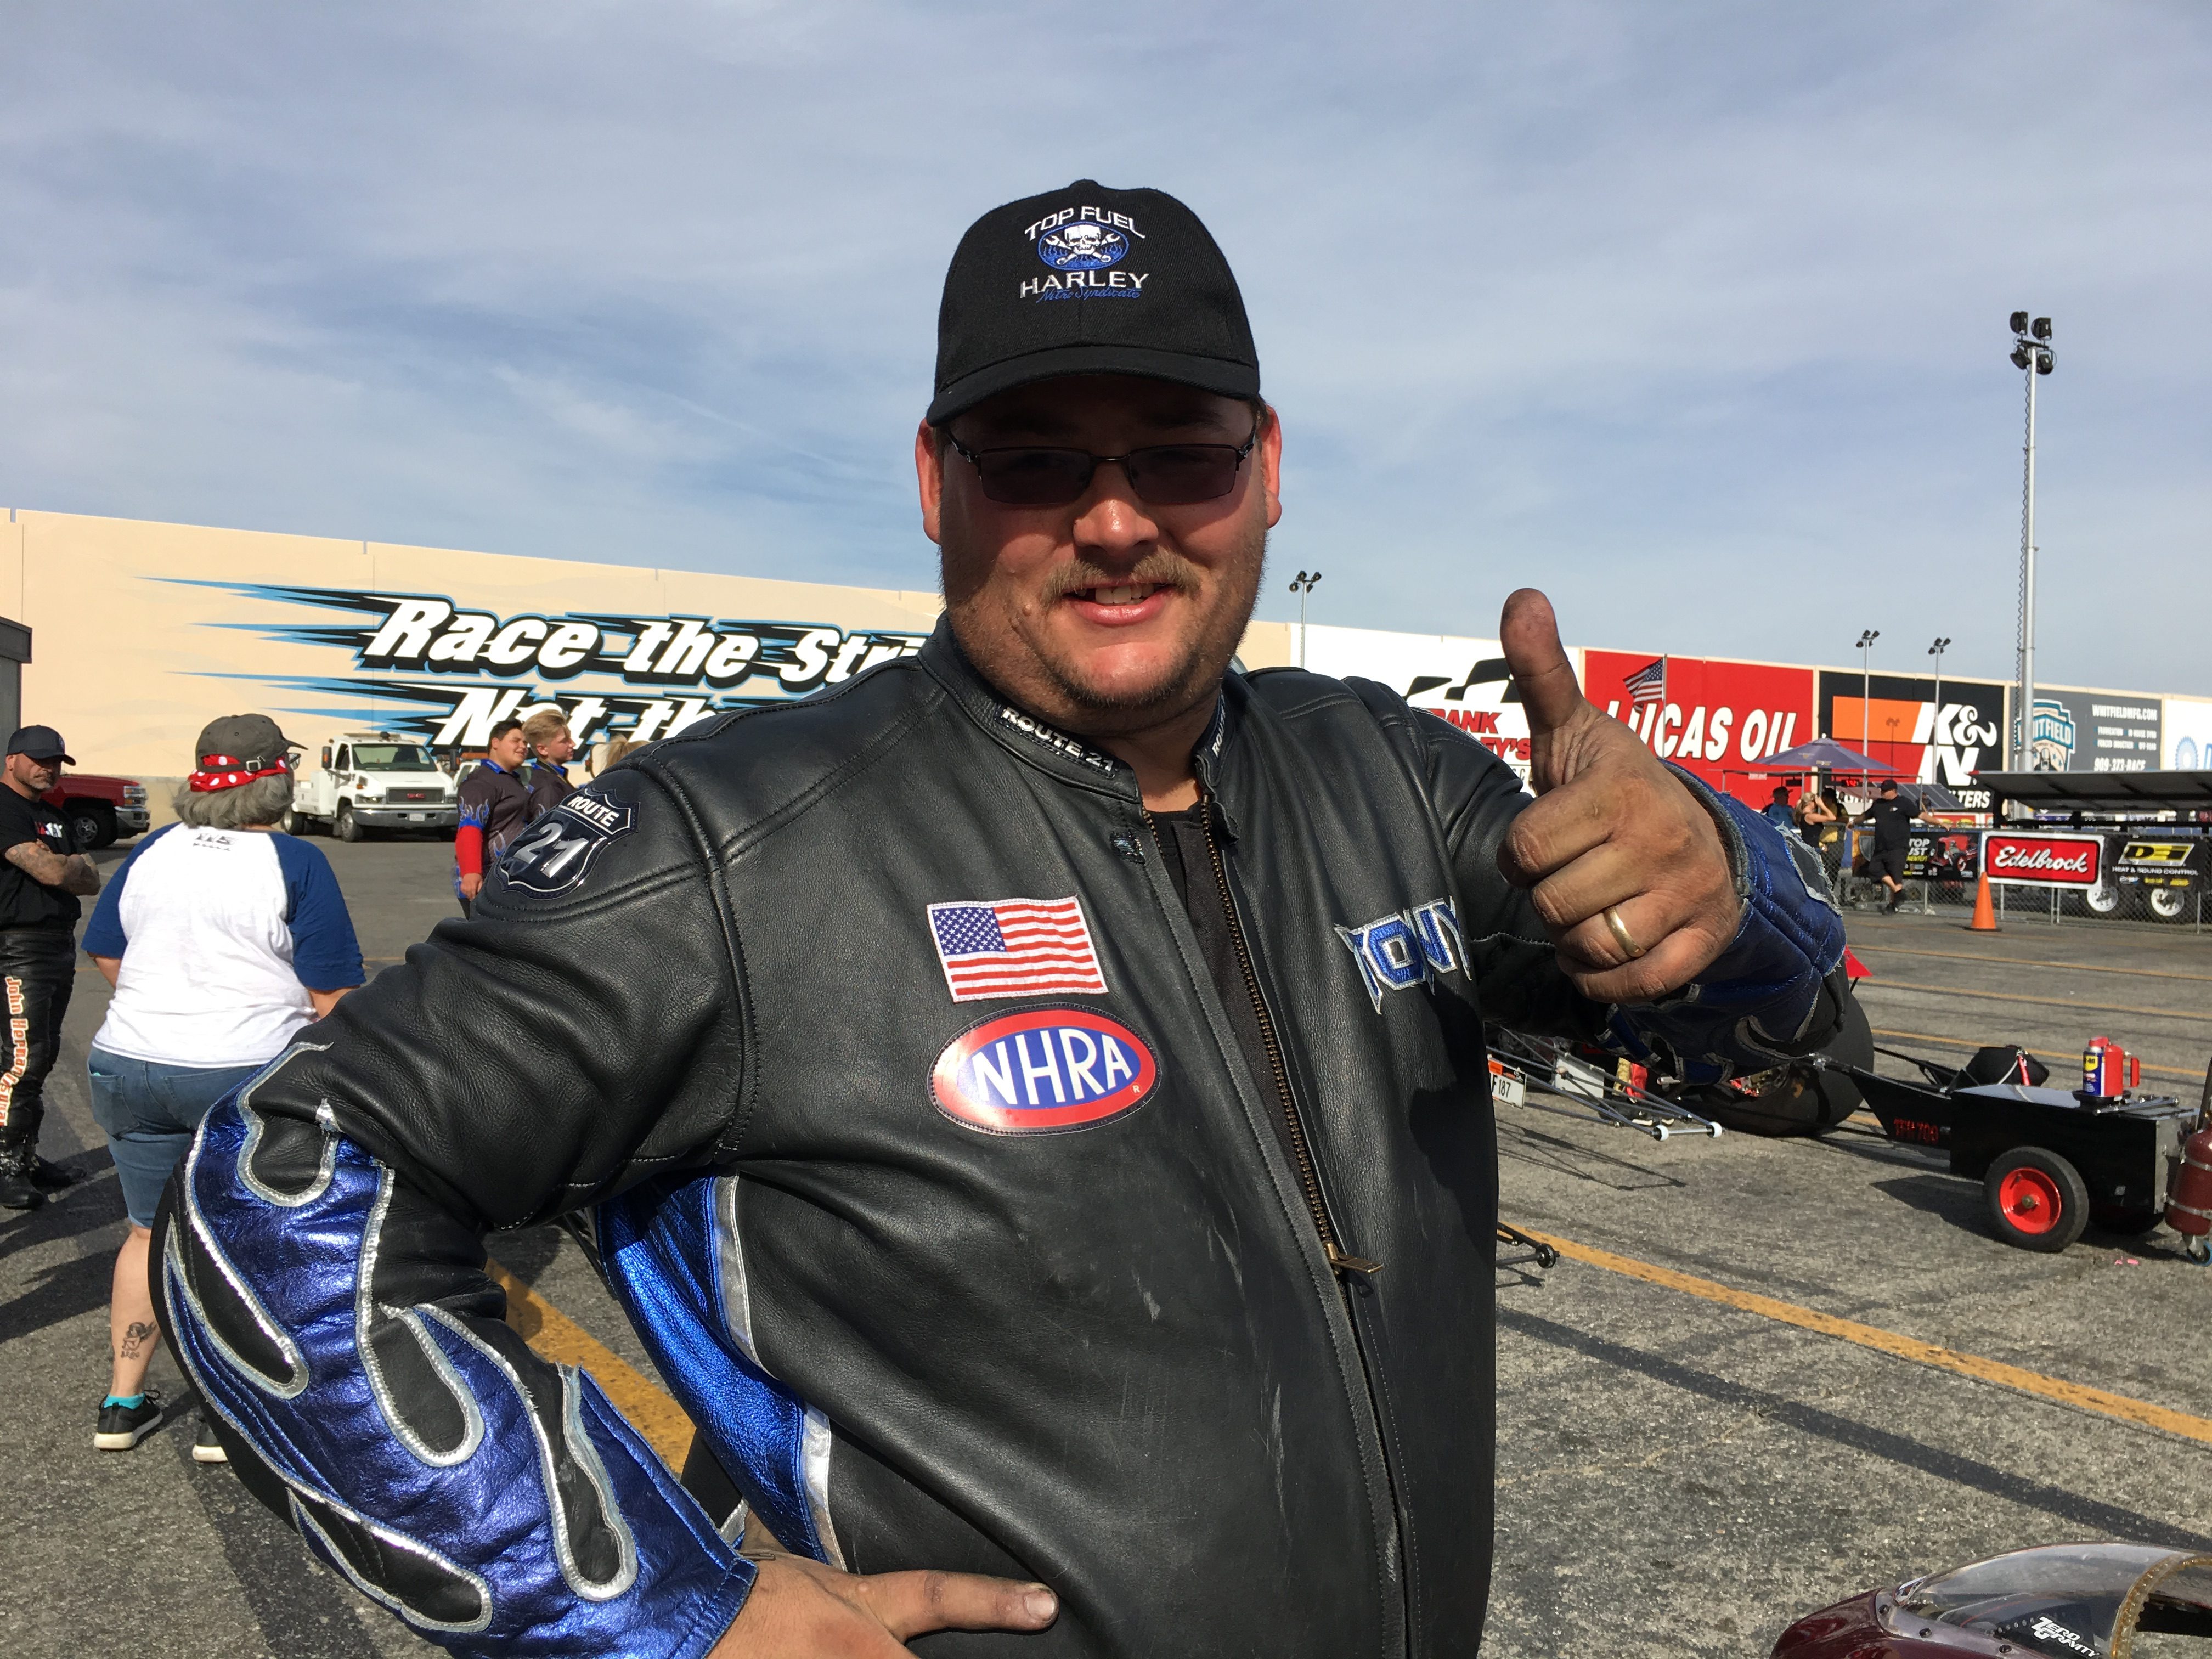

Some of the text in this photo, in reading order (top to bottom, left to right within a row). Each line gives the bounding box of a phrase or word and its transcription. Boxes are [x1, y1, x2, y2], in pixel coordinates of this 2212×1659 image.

[1024, 206, 1146, 241] TOP FUEL
[1020, 270, 1149, 298] HARLEY
[1036, 285, 1142, 303] Nitro Syndicate
[358, 596, 927, 683] Race the Str
[403, 682, 716, 751] Nt th
[2092, 704, 2158, 721] WHITFIELDMFG.COM
[1001, 707, 1114, 771] ROUTE 21
[1740, 709, 1797, 762] OIL
[567, 795, 619, 827] ROUTE
[514, 822, 589, 878] 21
[1995, 845, 2089, 873] Edelbrock
[5, 977, 24, 1015] John
[972, 1028, 1133, 1107] NHRA
[1499, 1079, 1511, 1098] 187
[2031, 1616, 2080, 1641] ZERO
[2034, 1630, 2101, 1657] GRAVITY
